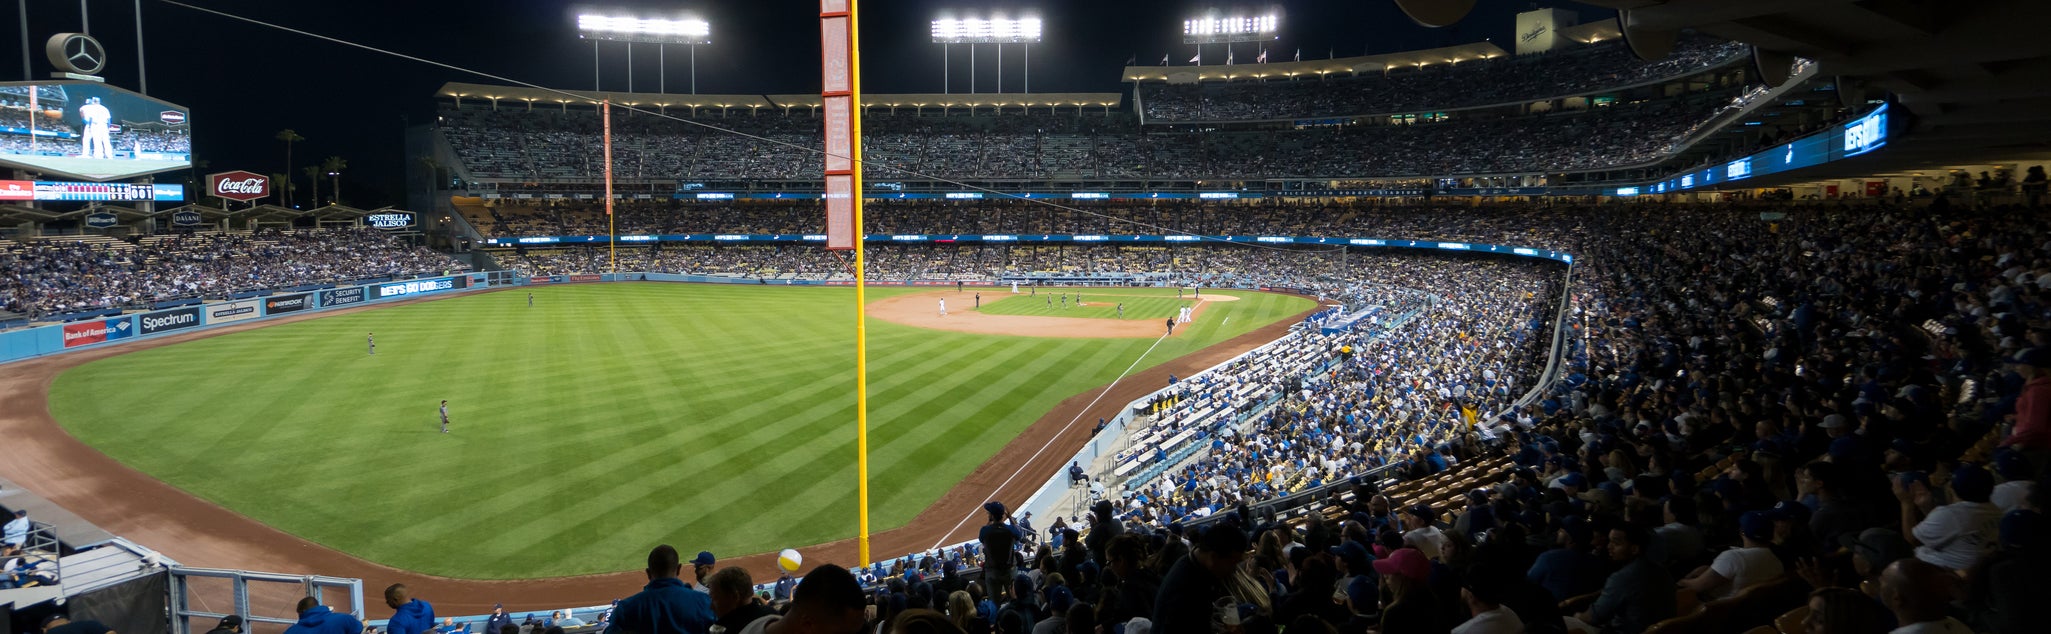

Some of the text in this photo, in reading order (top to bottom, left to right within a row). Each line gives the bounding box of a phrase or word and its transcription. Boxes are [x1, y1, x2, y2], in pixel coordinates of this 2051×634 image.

[218, 177, 265, 194] Coca-Cola
[369, 213, 411, 221] ESTRELLA
[335, 288, 362, 297] SECURITY
[143, 313, 193, 331] Spectrum
[65, 326, 116, 341] Bank of America
